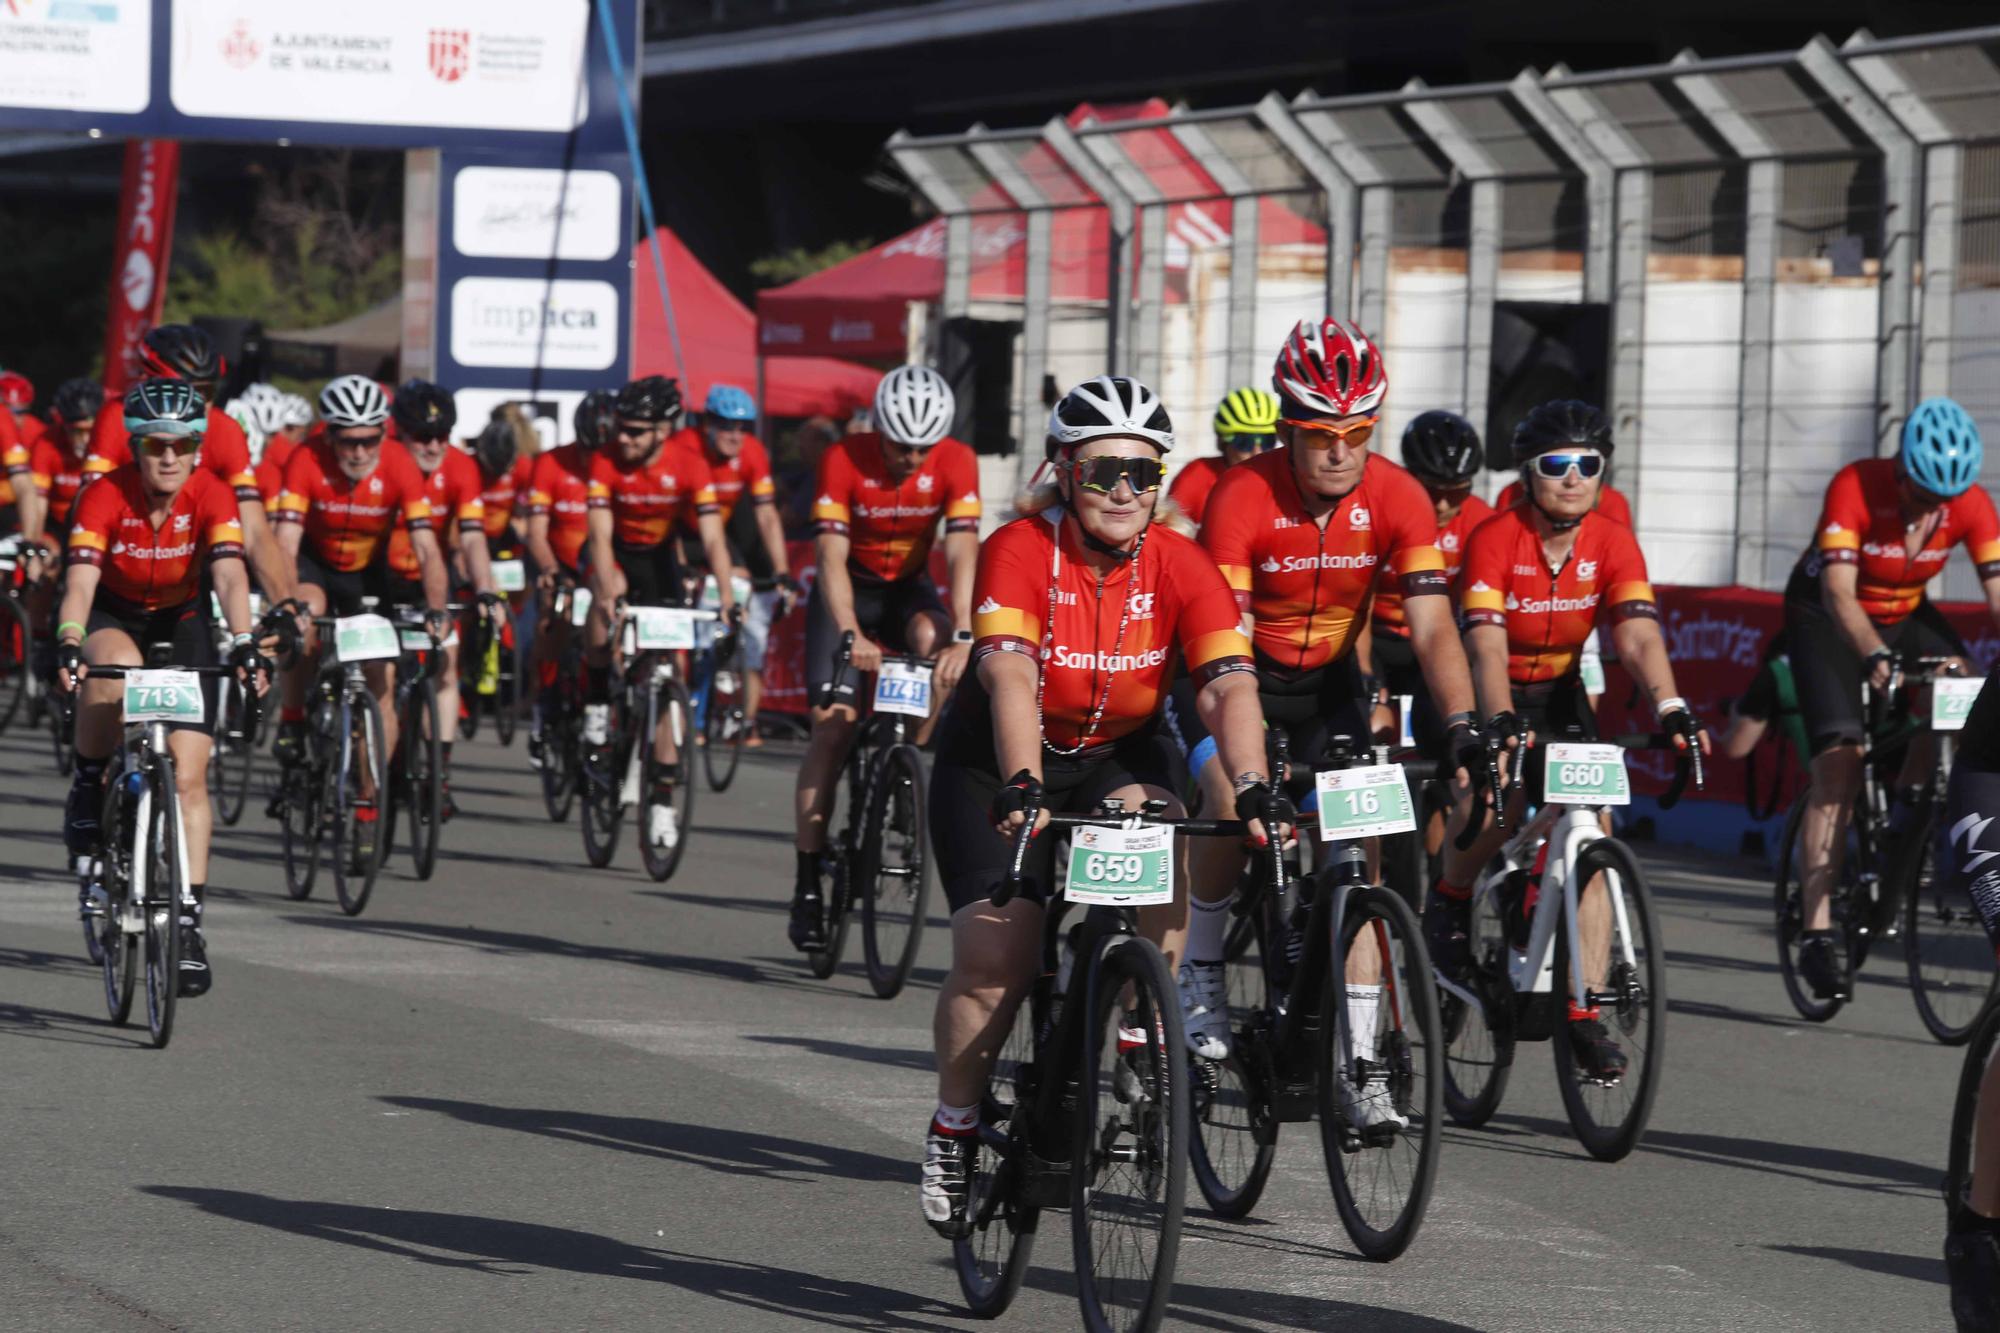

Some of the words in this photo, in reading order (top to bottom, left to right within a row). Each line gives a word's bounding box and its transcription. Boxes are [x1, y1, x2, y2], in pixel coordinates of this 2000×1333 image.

[1053, 645, 1169, 671] Santander
[136, 687, 178, 708] 713
[881, 679, 921, 701] 1741
[1559, 763, 1605, 786] 660
[1344, 789, 1380, 816] 16
[1085, 853, 1144, 883] 659
